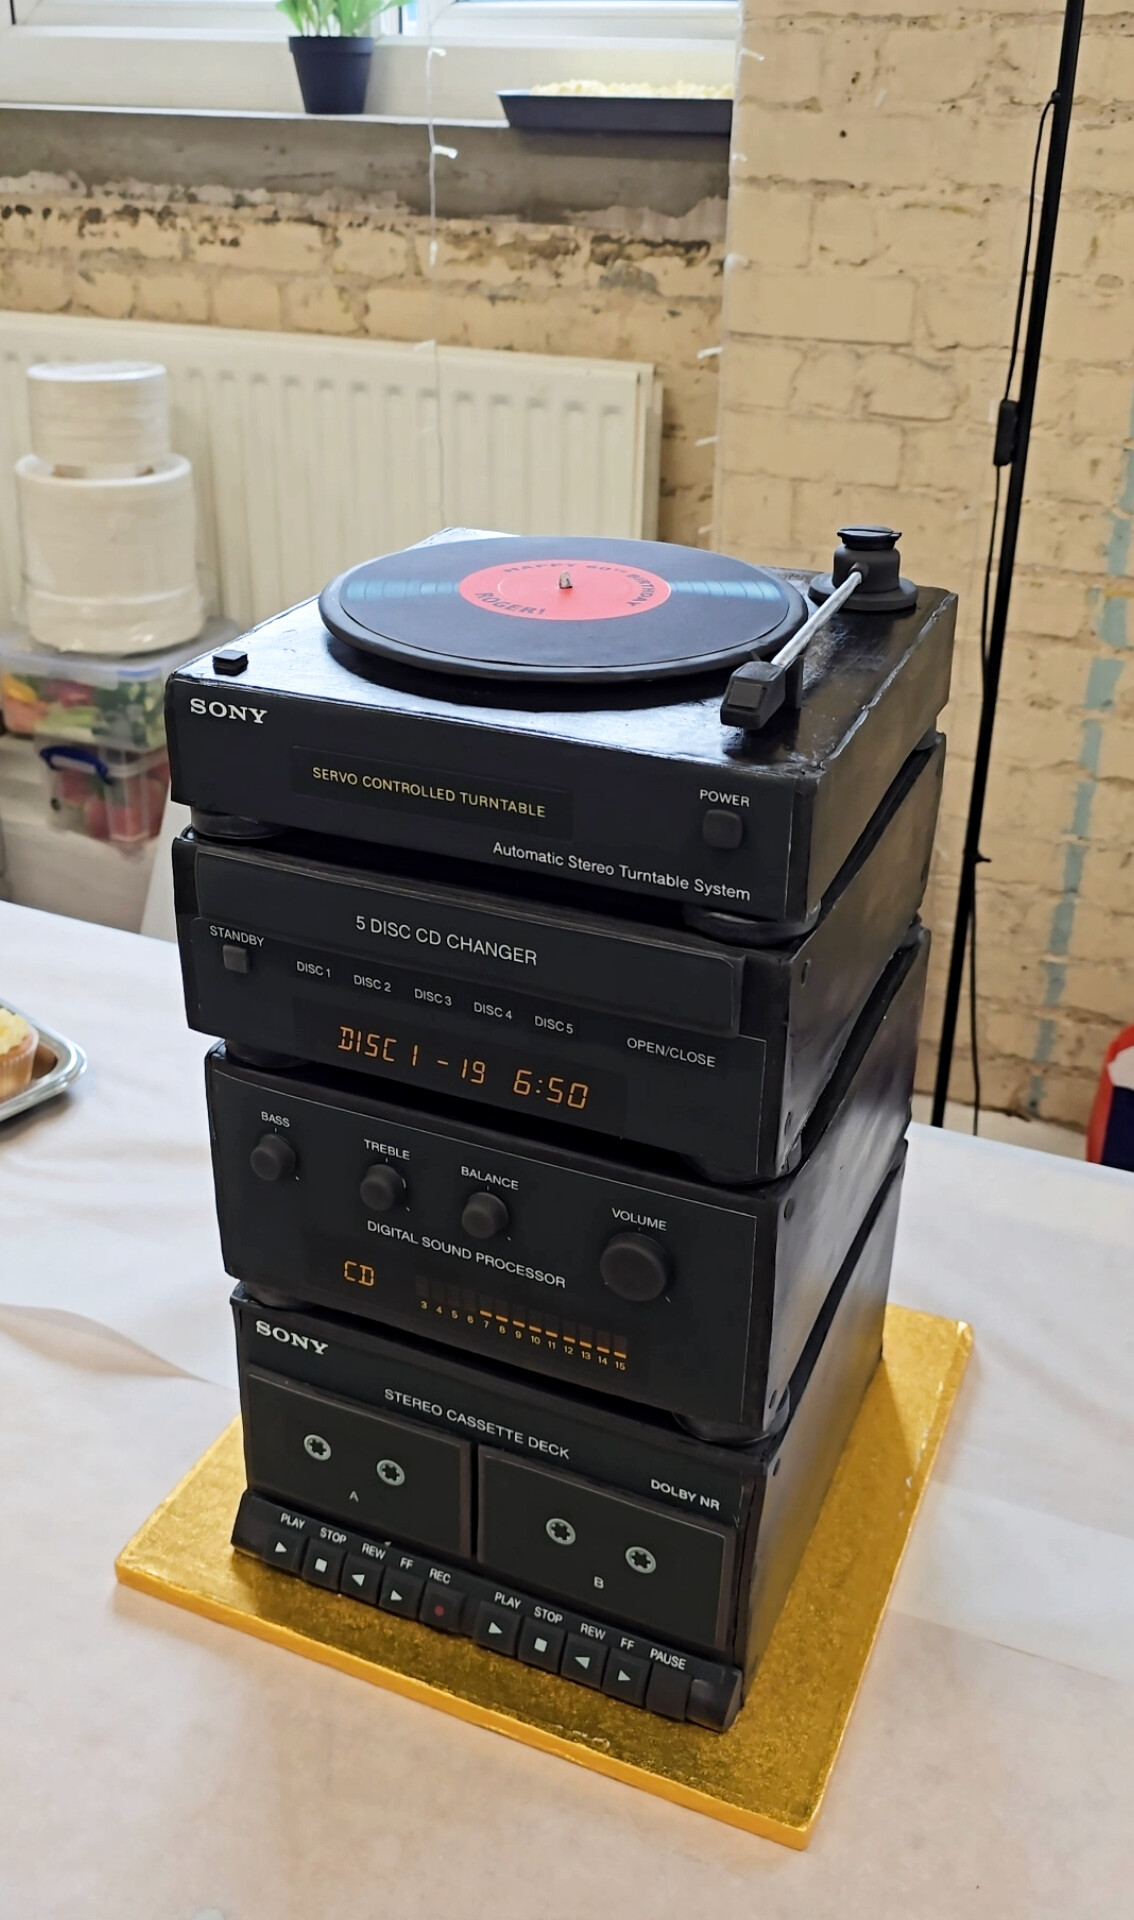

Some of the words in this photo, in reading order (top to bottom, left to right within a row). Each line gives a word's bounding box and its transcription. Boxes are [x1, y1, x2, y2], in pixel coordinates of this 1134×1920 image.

[503, 562, 577, 573] HAPPY
[626, 573, 656, 607] BIRTHDAY
[475, 591, 547, 615] ROGER!
[190, 698, 268, 724] SONY
[312, 766, 358, 786] SERVO
[362, 775, 456, 802] CONTROLLED
[459, 791, 546, 818] TURNTABLE
[699, 789, 750, 808] POWER
[493, 841, 565, 867] Automatic
[567, 855, 615, 876] Stereo
[618, 864, 690, 890] Turntable
[693, 878, 750, 902] System
[209, 925, 265, 947] STANDBY
[356, 915, 366, 931] 5
[371, 918, 412, 940] DISC
[415, 928, 442, 946] CD
[446, 934, 538, 966] CHANGER
[296, 960, 324, 977] DISC
[326, 968, 332, 978] 1
[353, 974, 382, 990] DISC
[383, 981, 392, 993] 2
[414, 988, 443, 1005] DISC
[444, 995, 453, 1007] 3
[473, 1001, 503, 1018] DISC
[505, 1010, 514, 1020] 4
[534, 1015, 564, 1033] DISC
[565, 1023, 574, 1034] 5
[626, 1037, 717, 1068] OPEN/CLOSE
[337, 1026, 398, 1063] DISC
[512, 1068, 590, 1110] 6:50
[260, 1111, 291, 1128] BASS
[363, 1138, 411, 1161] TREBLE
[460, 1165, 520, 1191] BALANCE
[611, 1207, 668, 1231] VOLUME
[366, 1220, 419, 1245] DIGITAL
[421, 1236, 473, 1260] SOUND
[475, 1252, 567, 1289] PROCESSOR
[343, 1260, 375, 1287] CD
[255, 1319, 329, 1355] SONY
[420, 1300, 428, 1310] 3
[435, 1305, 443, 1315] 4
[451, 1309, 459, 1319] 5
[466, 1314, 474, 1324] 6
[483, 1319, 490, 1329] 7
[498, 1324, 506, 1335] 8
[514, 1330, 522, 1340] 9
[530, 1334, 541, 1345] 10
[547, 1340, 556, 1350] 11
[563, 1344, 574, 1355] 12
[581, 1350, 592, 1361] 13
[597, 1354, 608, 1366] 14
[614, 1360, 626, 1371] 15
[384, 1388, 442, 1417] STEREO
[446, 1408, 524, 1445] CASSETTE
[527, 1435, 570, 1460] DECK
[650, 1478, 697, 1503] DOLBY
[699, 1495, 721, 1511] NR
[280, 1512, 306, 1530] PLAY
[319, 1527, 347, 1545] STOP
[361, 1542, 386, 1561] REW
[399, 1557, 414, 1569] FF
[429, 1568, 451, 1585] REC
[593, 1576, 604, 1589] B
[494, 1591, 521, 1610] PLAY
[533, 1605, 563, 1624] STOP
[580, 1622, 606, 1641] REW
[619, 1637, 635, 1650] FF
[650, 1647, 686, 1671] PAUSE
